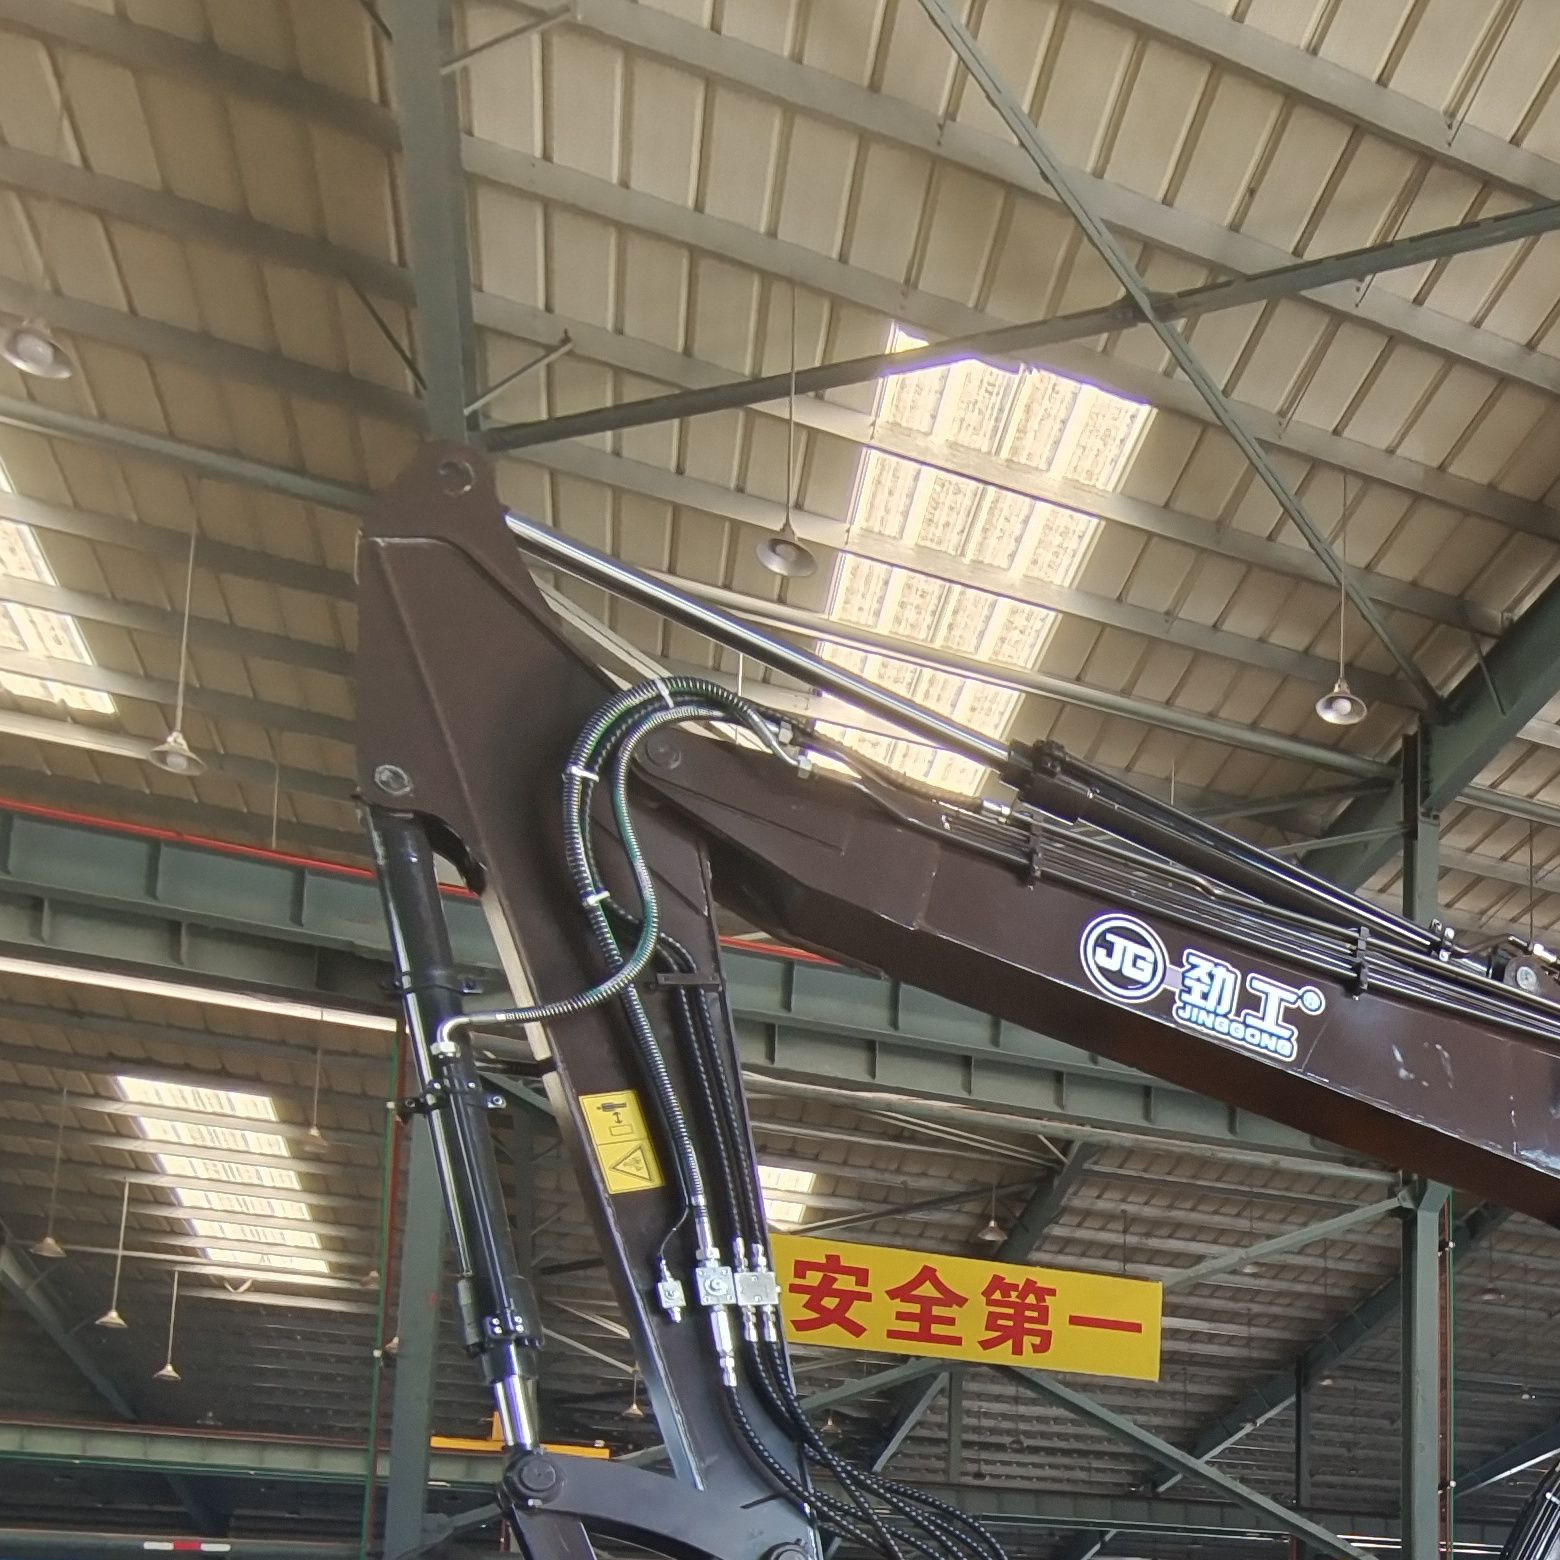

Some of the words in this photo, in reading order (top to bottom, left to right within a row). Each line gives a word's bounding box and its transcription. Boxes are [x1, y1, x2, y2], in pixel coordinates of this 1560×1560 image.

[1094, 932, 1156, 984] JG
[1176, 1003, 1295, 1059] JINGGONG
[788, 1254, 1143, 1356] 安全第一
